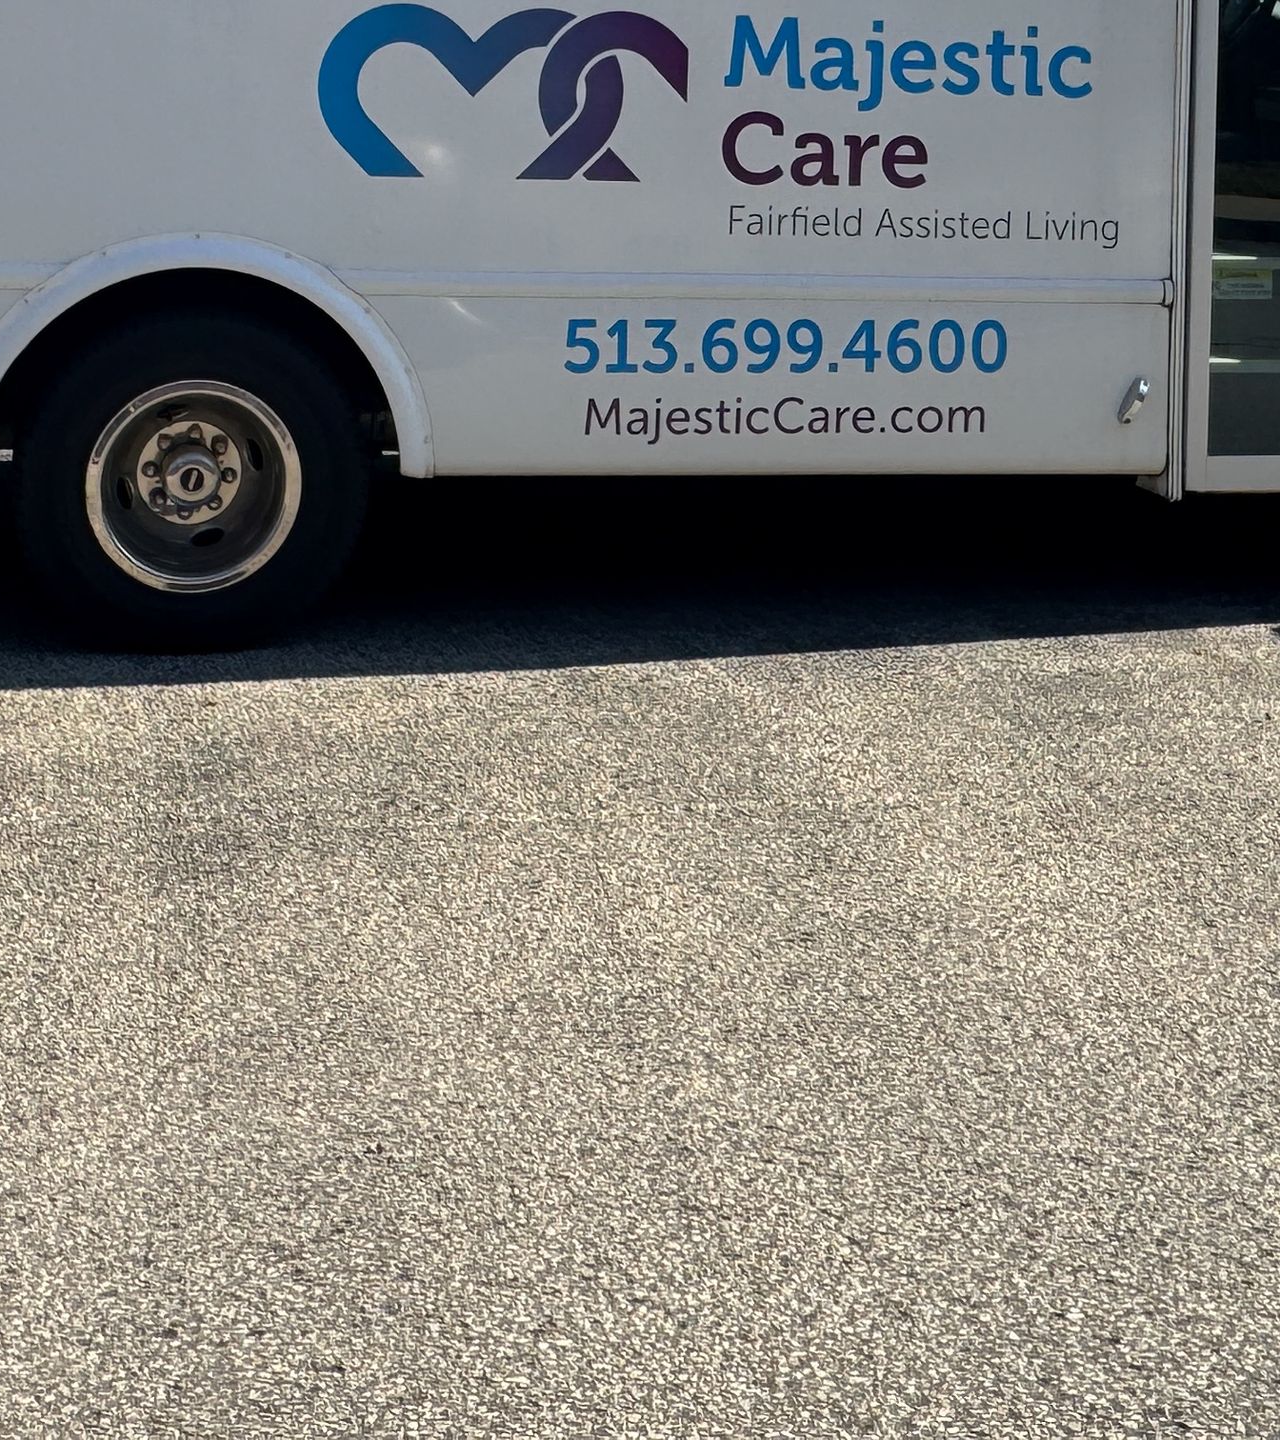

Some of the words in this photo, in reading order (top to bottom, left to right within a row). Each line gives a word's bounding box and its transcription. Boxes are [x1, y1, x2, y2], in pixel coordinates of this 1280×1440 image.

[723, 14, 1094, 113] Majestic
[721, 110, 929, 190] Care
[728, 204, 862, 239] Fairfield
[874, 208, 1012, 241] Assisted
[1026, 210, 1120, 250] Living
[563, 317, 1008, 375] 513.699.4600
[584, 396, 986, 446] MajesticCare.com
